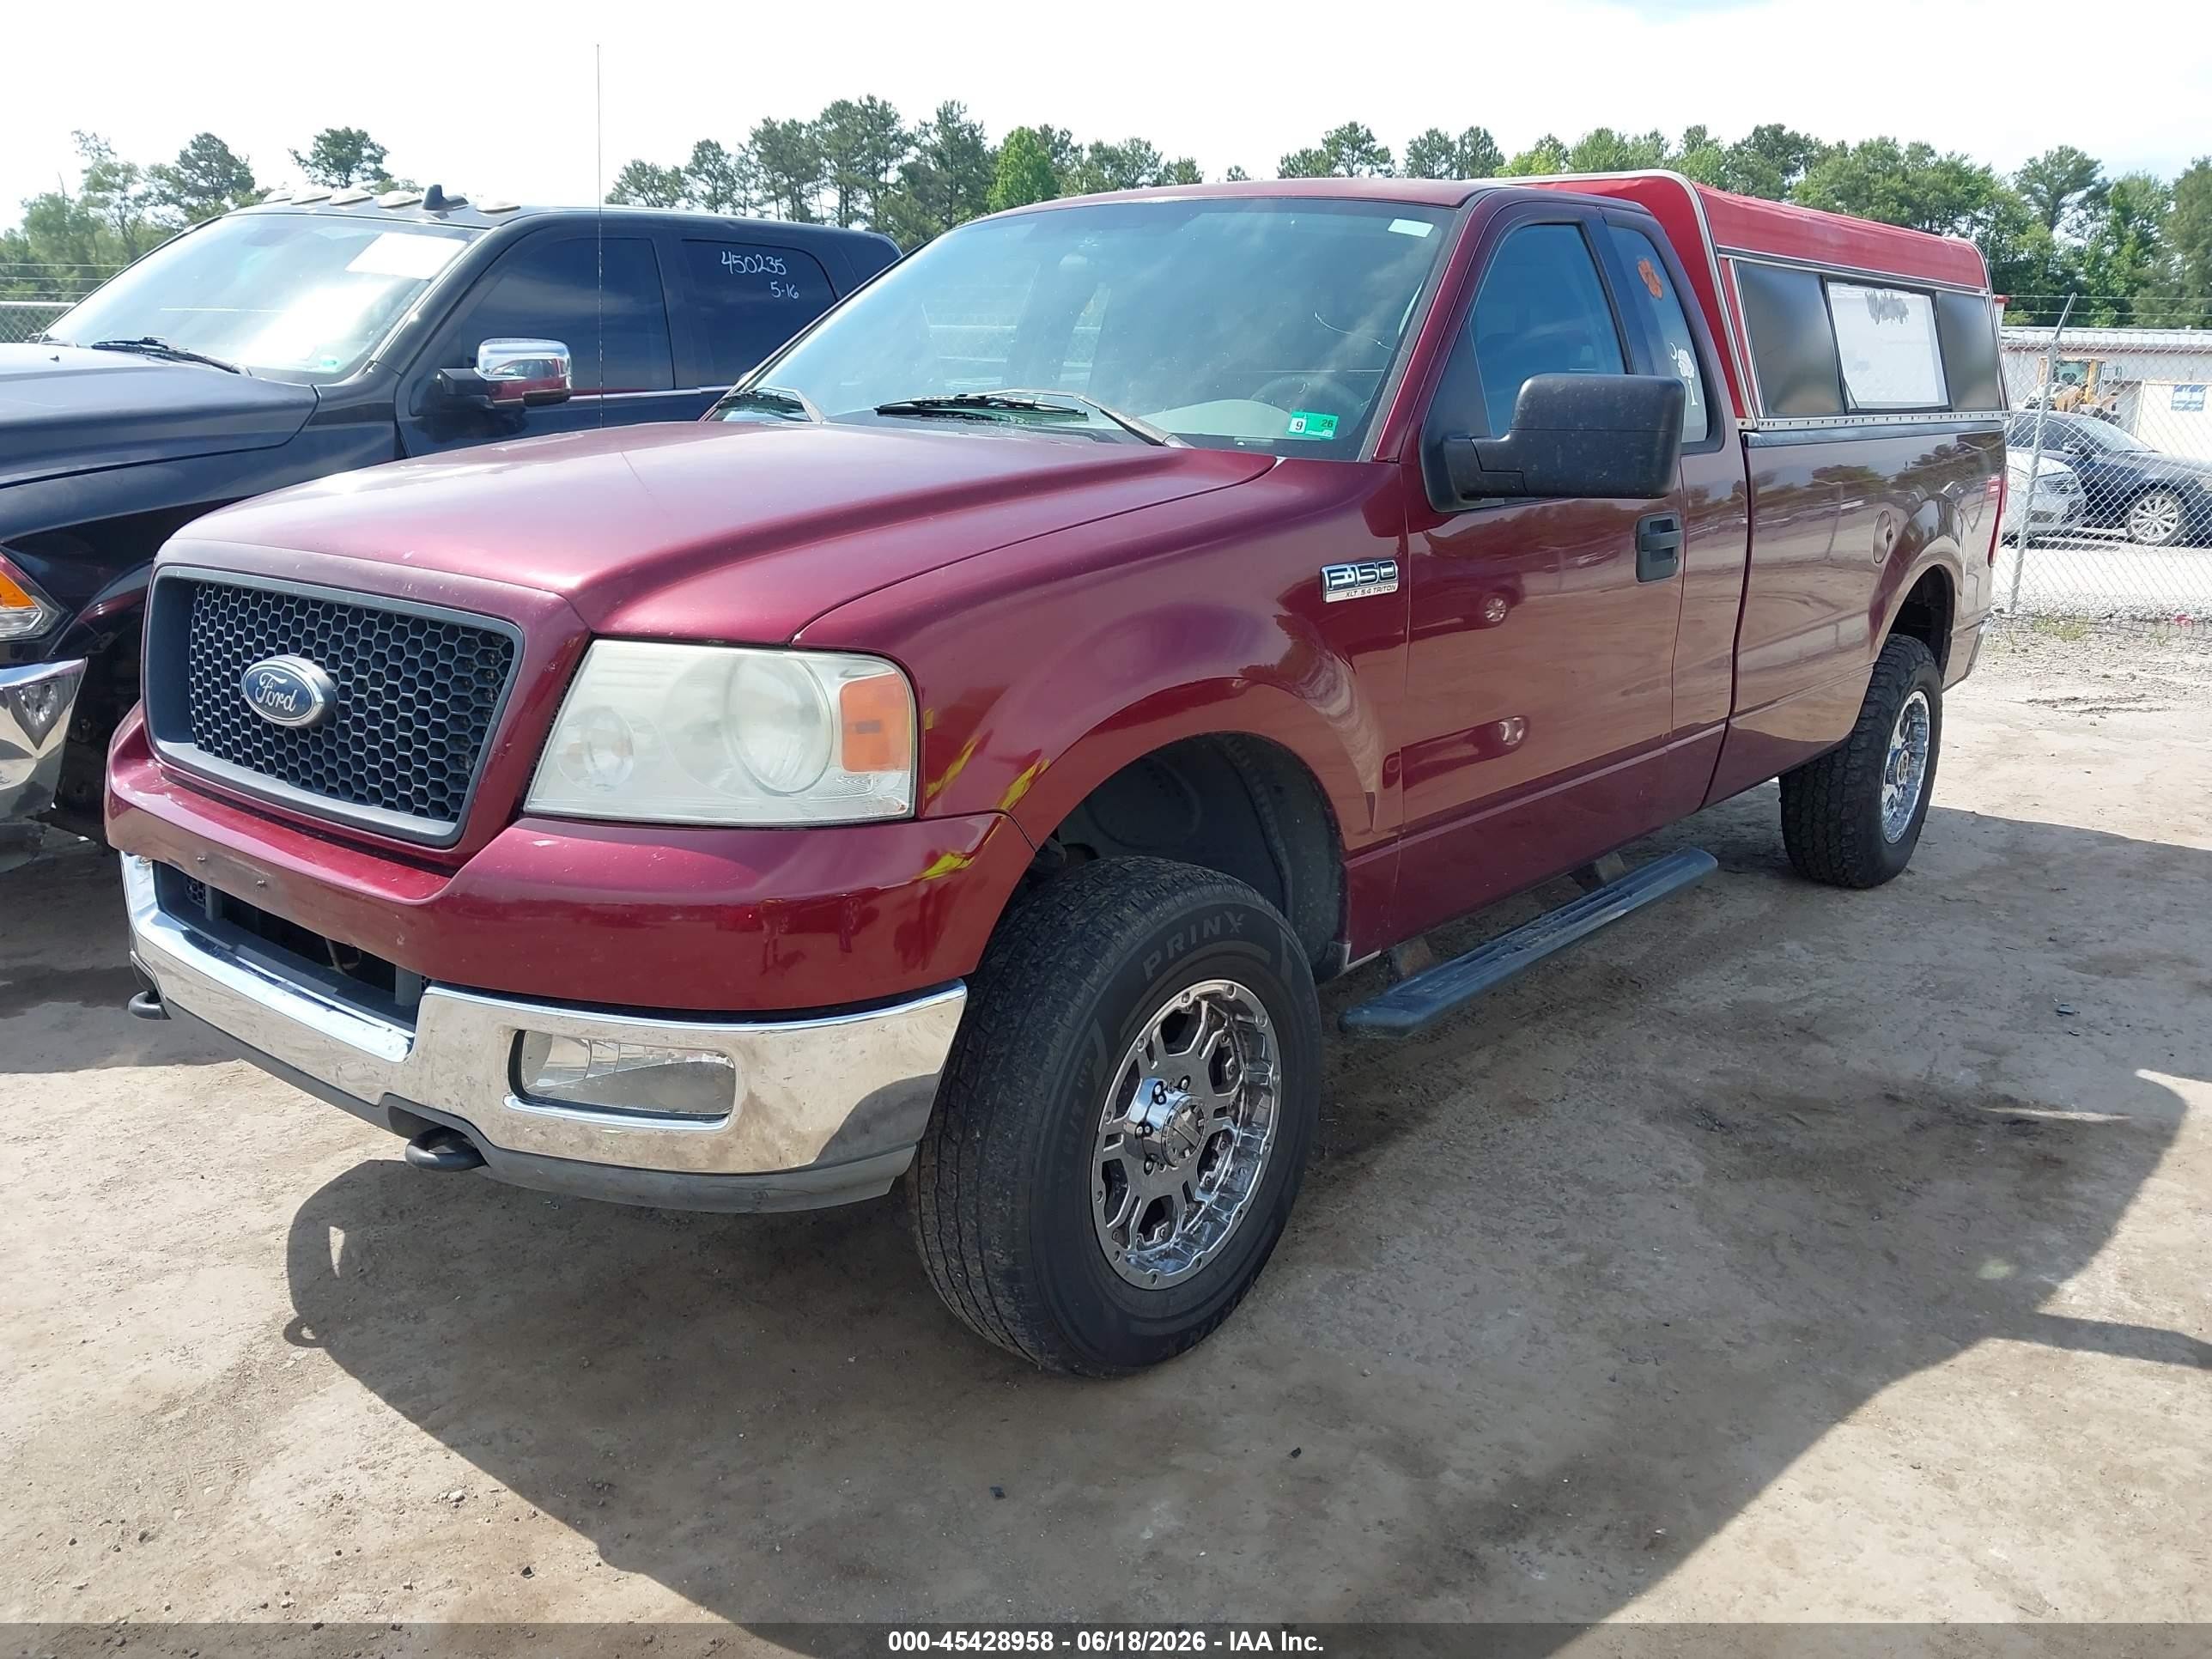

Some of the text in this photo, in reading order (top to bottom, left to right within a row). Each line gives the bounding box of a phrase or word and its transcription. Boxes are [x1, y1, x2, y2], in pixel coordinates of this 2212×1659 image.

[721, 251, 787, 275] 450235
[770, 281, 799, 299] 5-16
[1295, 418, 1334, 431] 9 26
[1323, 560, 1398, 591] F-150
[1346, 590, 1358, 599] XLT
[1373, 584, 1396, 594] TRITON
[255, 672, 298, 712] Ford
[1143, 910, 1247, 981] PRINX
